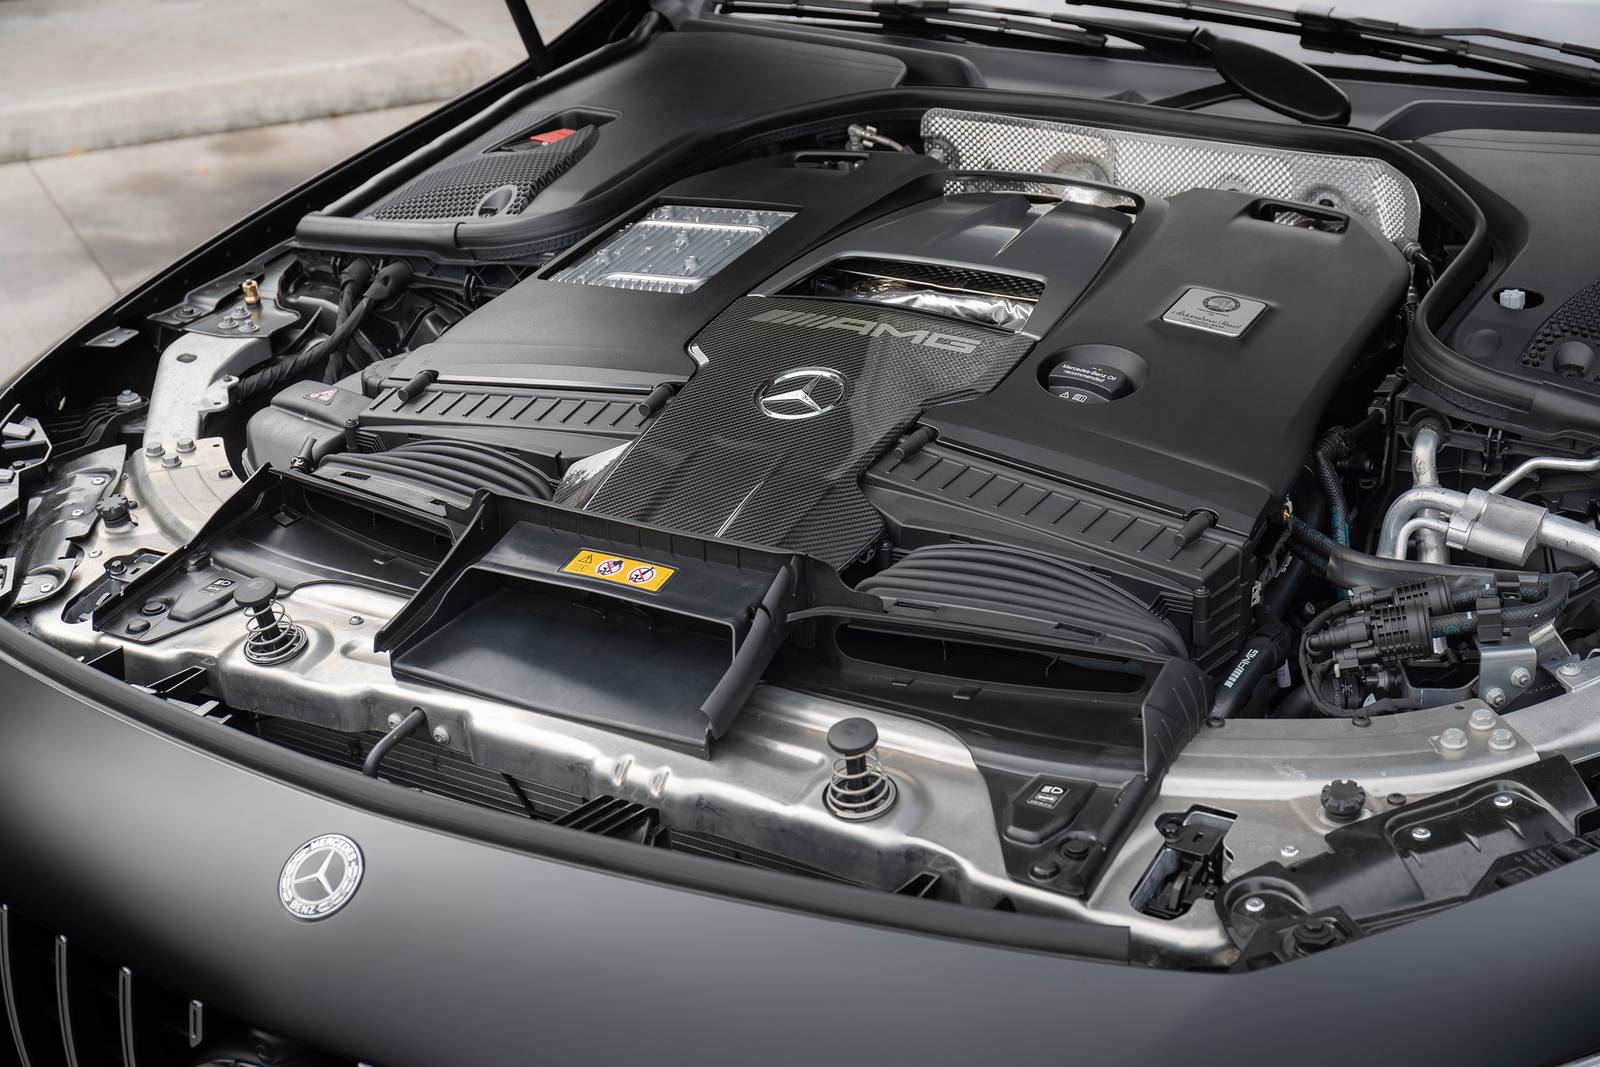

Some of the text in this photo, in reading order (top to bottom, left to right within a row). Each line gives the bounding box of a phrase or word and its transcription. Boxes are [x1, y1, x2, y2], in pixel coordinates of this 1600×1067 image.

[816, 316, 982, 354] AMG
[1062, 363, 1107, 379] Mercedes-Benz
[1063, 369, 1106, 383] recommended
[310, 837, 357, 861] MERCEDES
[289, 899, 316, 914] BENZ
